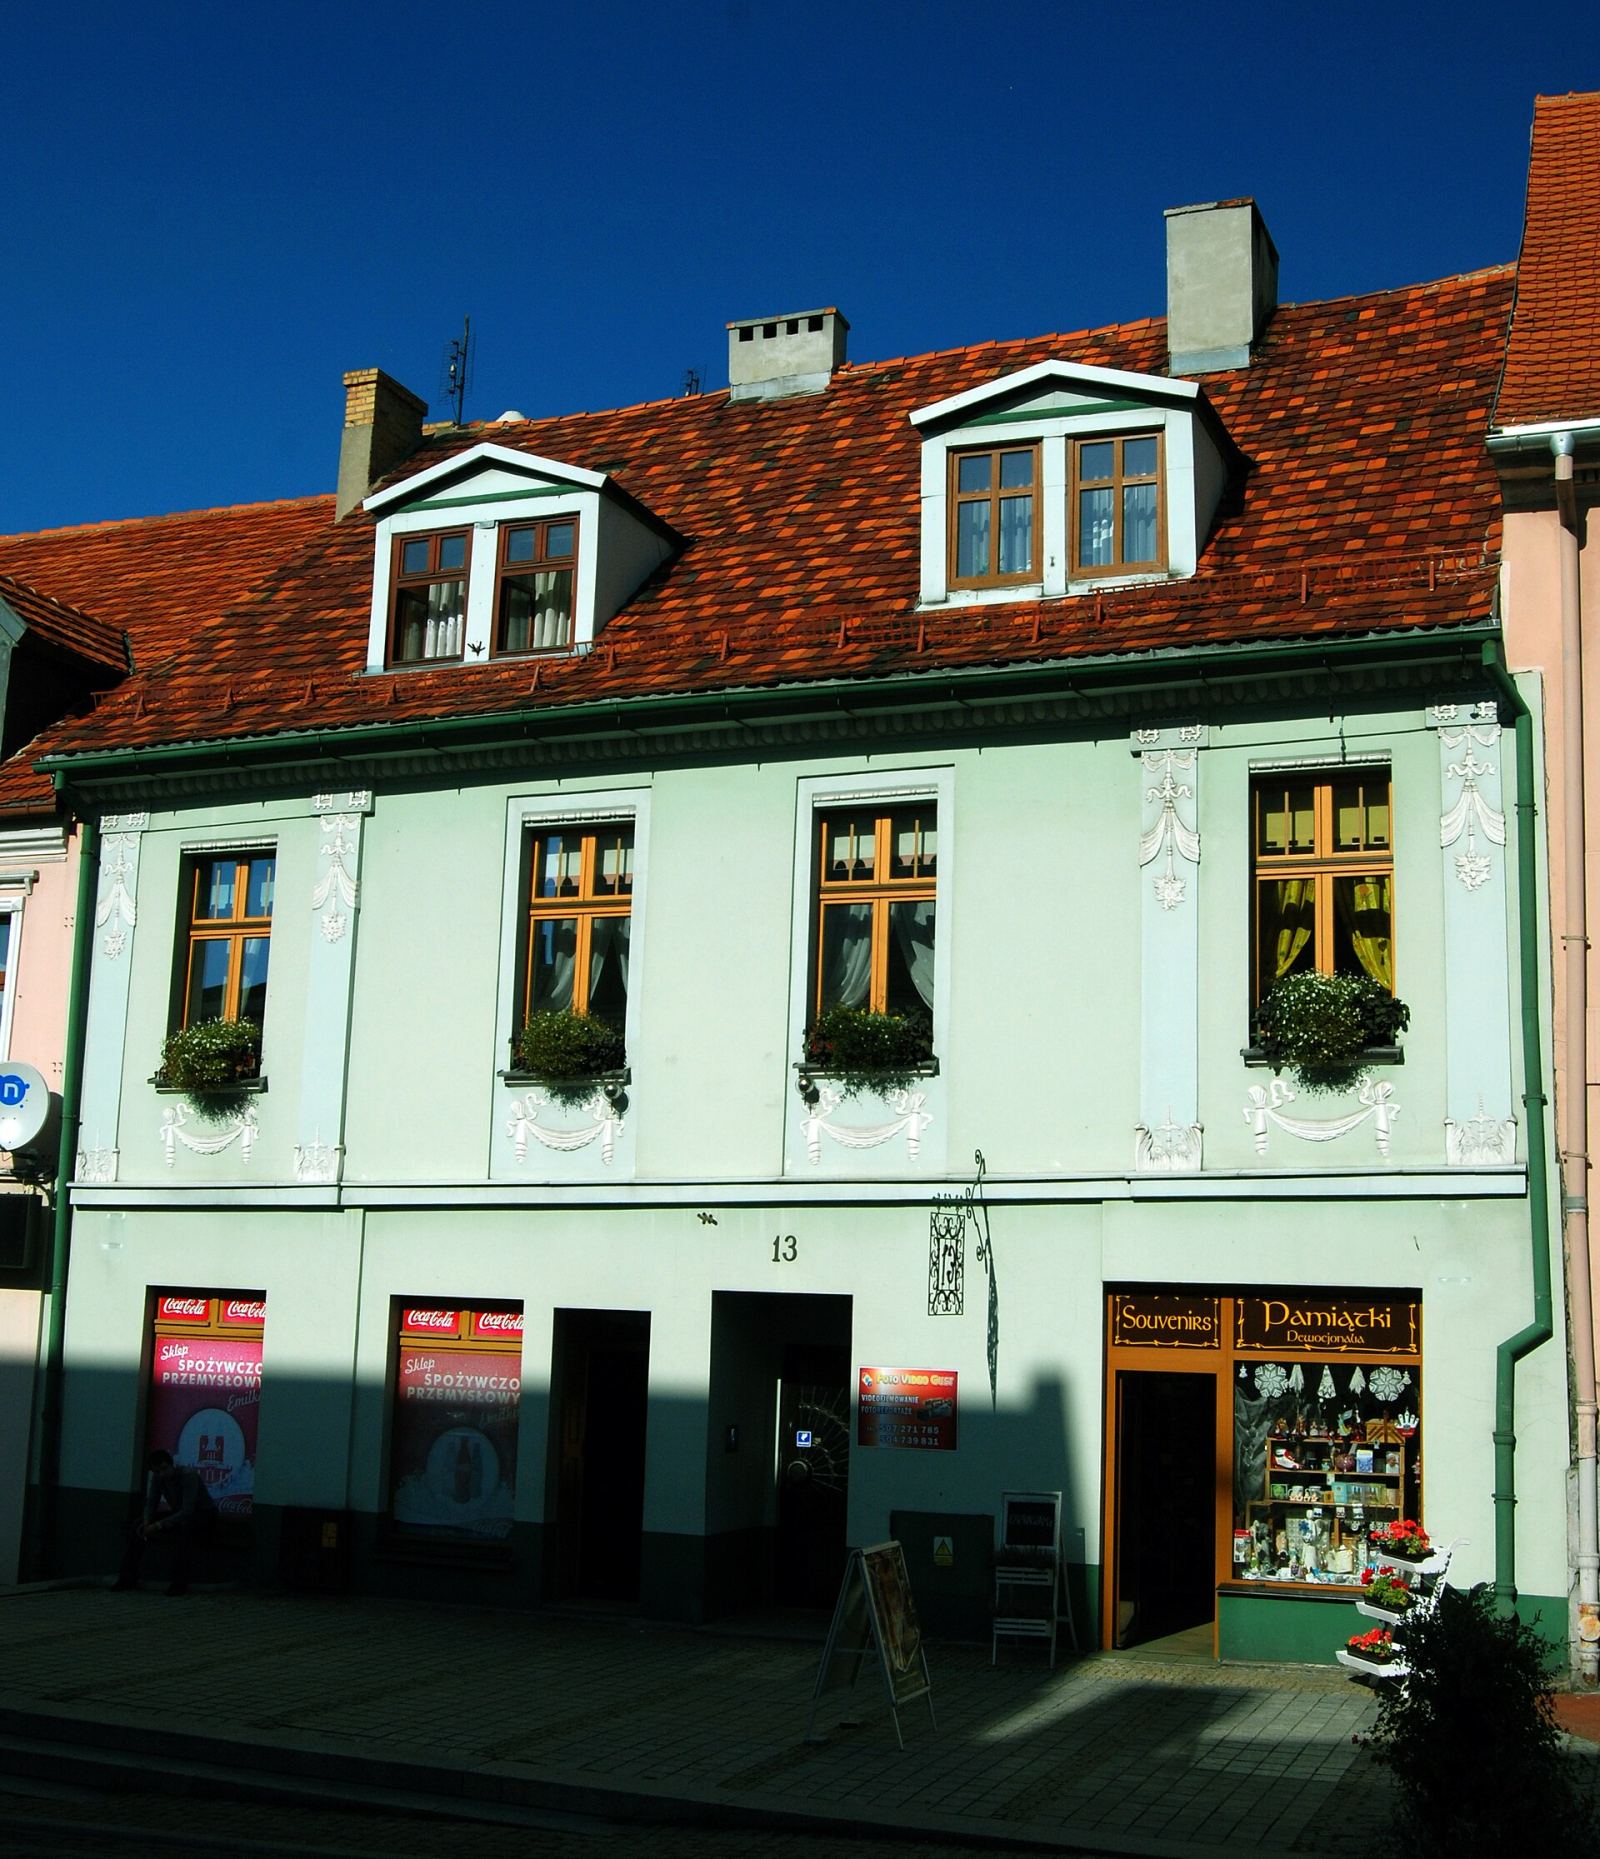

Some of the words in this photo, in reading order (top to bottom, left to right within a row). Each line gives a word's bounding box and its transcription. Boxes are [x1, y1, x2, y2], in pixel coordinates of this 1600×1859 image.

[772, 1235, 798, 1262] 13
[163, 1297, 206, 1316] Coca-Cola
[407, 1309, 454, 1328] Coca-Cola
[1122, 1305, 1211, 1331] Souvenirs
[1263, 1301, 1392, 1333] Pamiątki
[1287, 1329, 1365, 1345] Dewocjonalia
[160, 1344, 190, 1361] Sklep
[404, 1357, 436, 1374] Sklep
[424, 1371, 521, 1390] SPOŻYWCZO
[406, 1387, 521, 1405] PRZEMYSŁOWY
